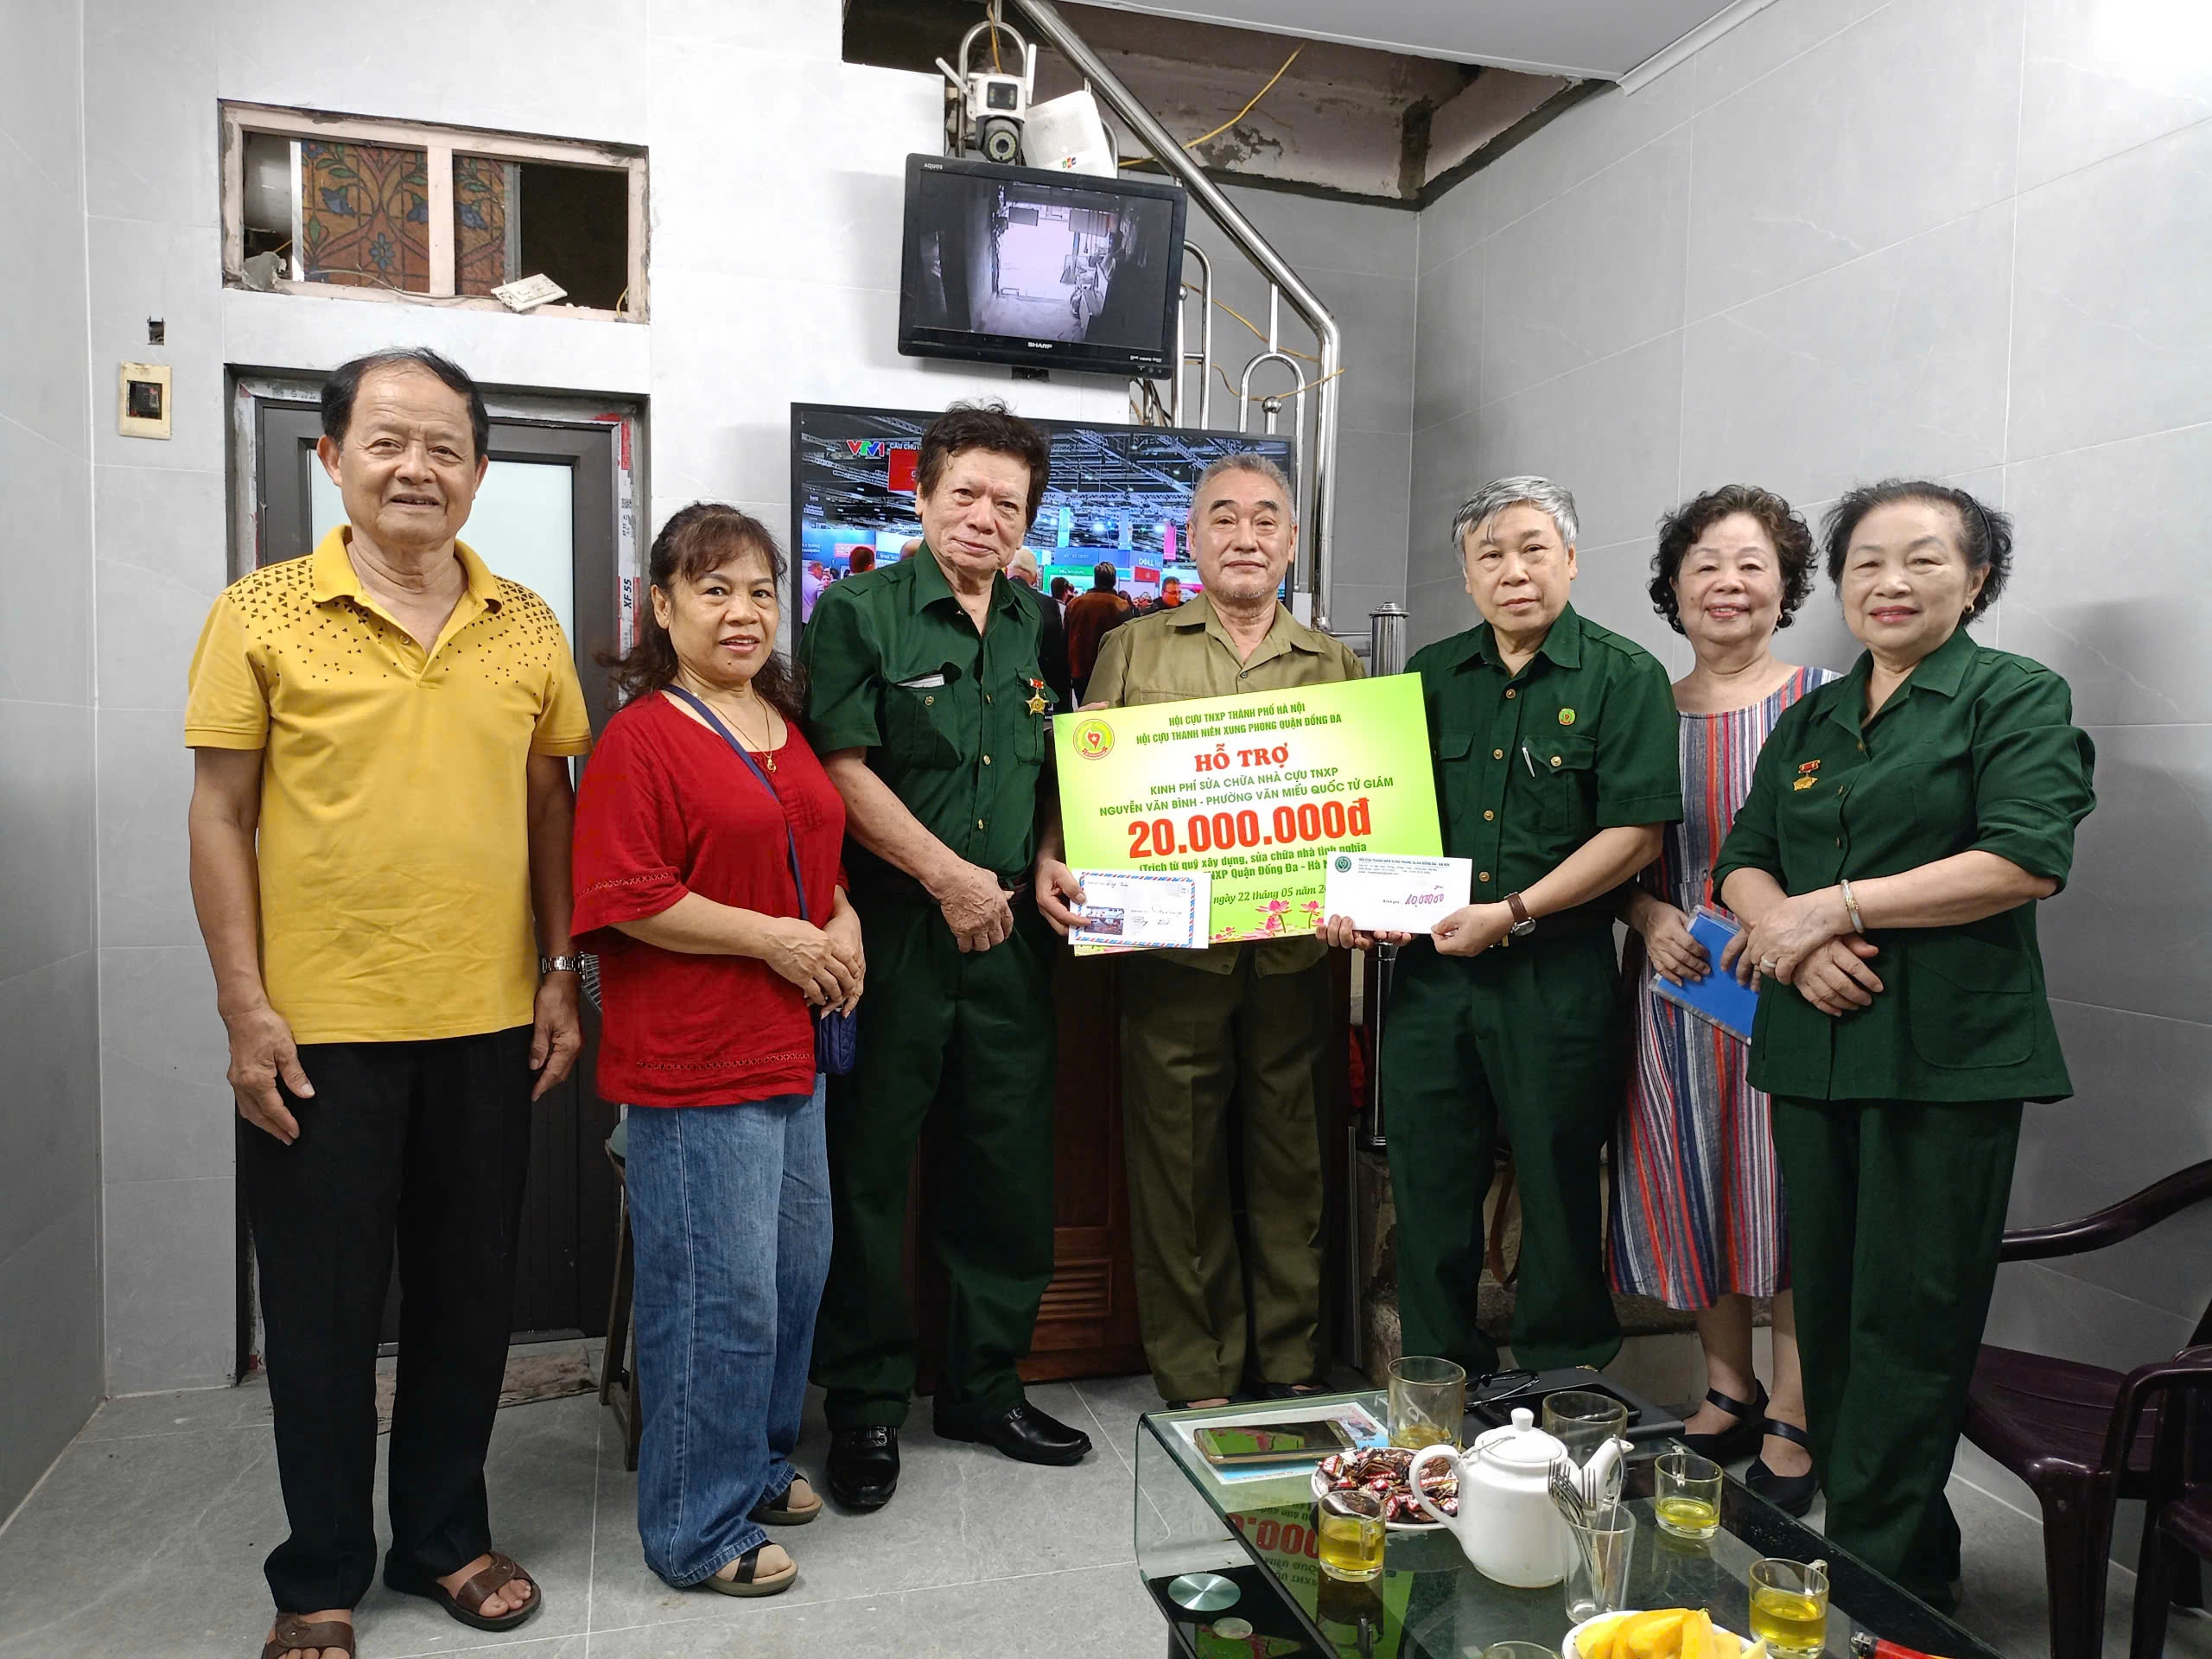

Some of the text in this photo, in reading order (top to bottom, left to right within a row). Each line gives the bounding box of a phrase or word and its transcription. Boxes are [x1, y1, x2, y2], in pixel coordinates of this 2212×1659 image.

[847, 440, 885, 457] VTV1
[623, 578, 632, 608] XF 55
[1169, 702, 1306, 727] HỘI CỰU TNXP THÀNH PHỐ HÀ NỘI
[1136, 733, 1150, 746] HỘI
[1153, 733, 1169, 743] CỰU
[1172, 729, 1198, 741] THANH
[1201, 726, 1221, 737] NIÊN
[1224, 725, 1246, 734] XUNG
[1249, 721, 1277, 732] PHONG
[1280, 718, 1302, 729] QUẬN
[1330, 714, 1342, 723] ĐA
[1194, 742, 1288, 772] HỖ TRỢ
[1150, 767, 1338, 795] KINH PHÍ SỬA CHỮA NHÀ CỰU TNXP
[1099, 800, 1142, 816] NGUYỄN
[1146, 800, 1168, 811] VĂN
[1172, 798, 1197, 810] BÌNH
[1206, 791, 1253, 805] PHƯỜNG
[1255, 788, 1279, 799] VĂN
[1282, 783, 1307, 798] MIẾU
[1311, 779, 1344, 794] QUỐC
[1363, 776, 1394, 788] GIÁM
[1128, 798, 1371, 859] 20.000.000đ
[1182, 859, 1198, 869] quỹ
[1202, 857, 1218, 868] xây
[1221, 856, 1248, 867] dựng,
[1250, 851, 1268, 862] sửa
[1271, 850, 1294, 861] chữa
[1297, 847, 1315, 857] nhà
[1230, 867, 1255, 880] Quận
[1286, 863, 1299, 873] Đa
[1307, 860, 1321, 870] Hà
[1213, 893, 1236, 905] ngày
[1238, 892, 1250, 901] 22
[1252, 890, 1279, 900] tháng
[1281, 887, 1293, 897] 05
[1295, 886, 1316, 896] năm
